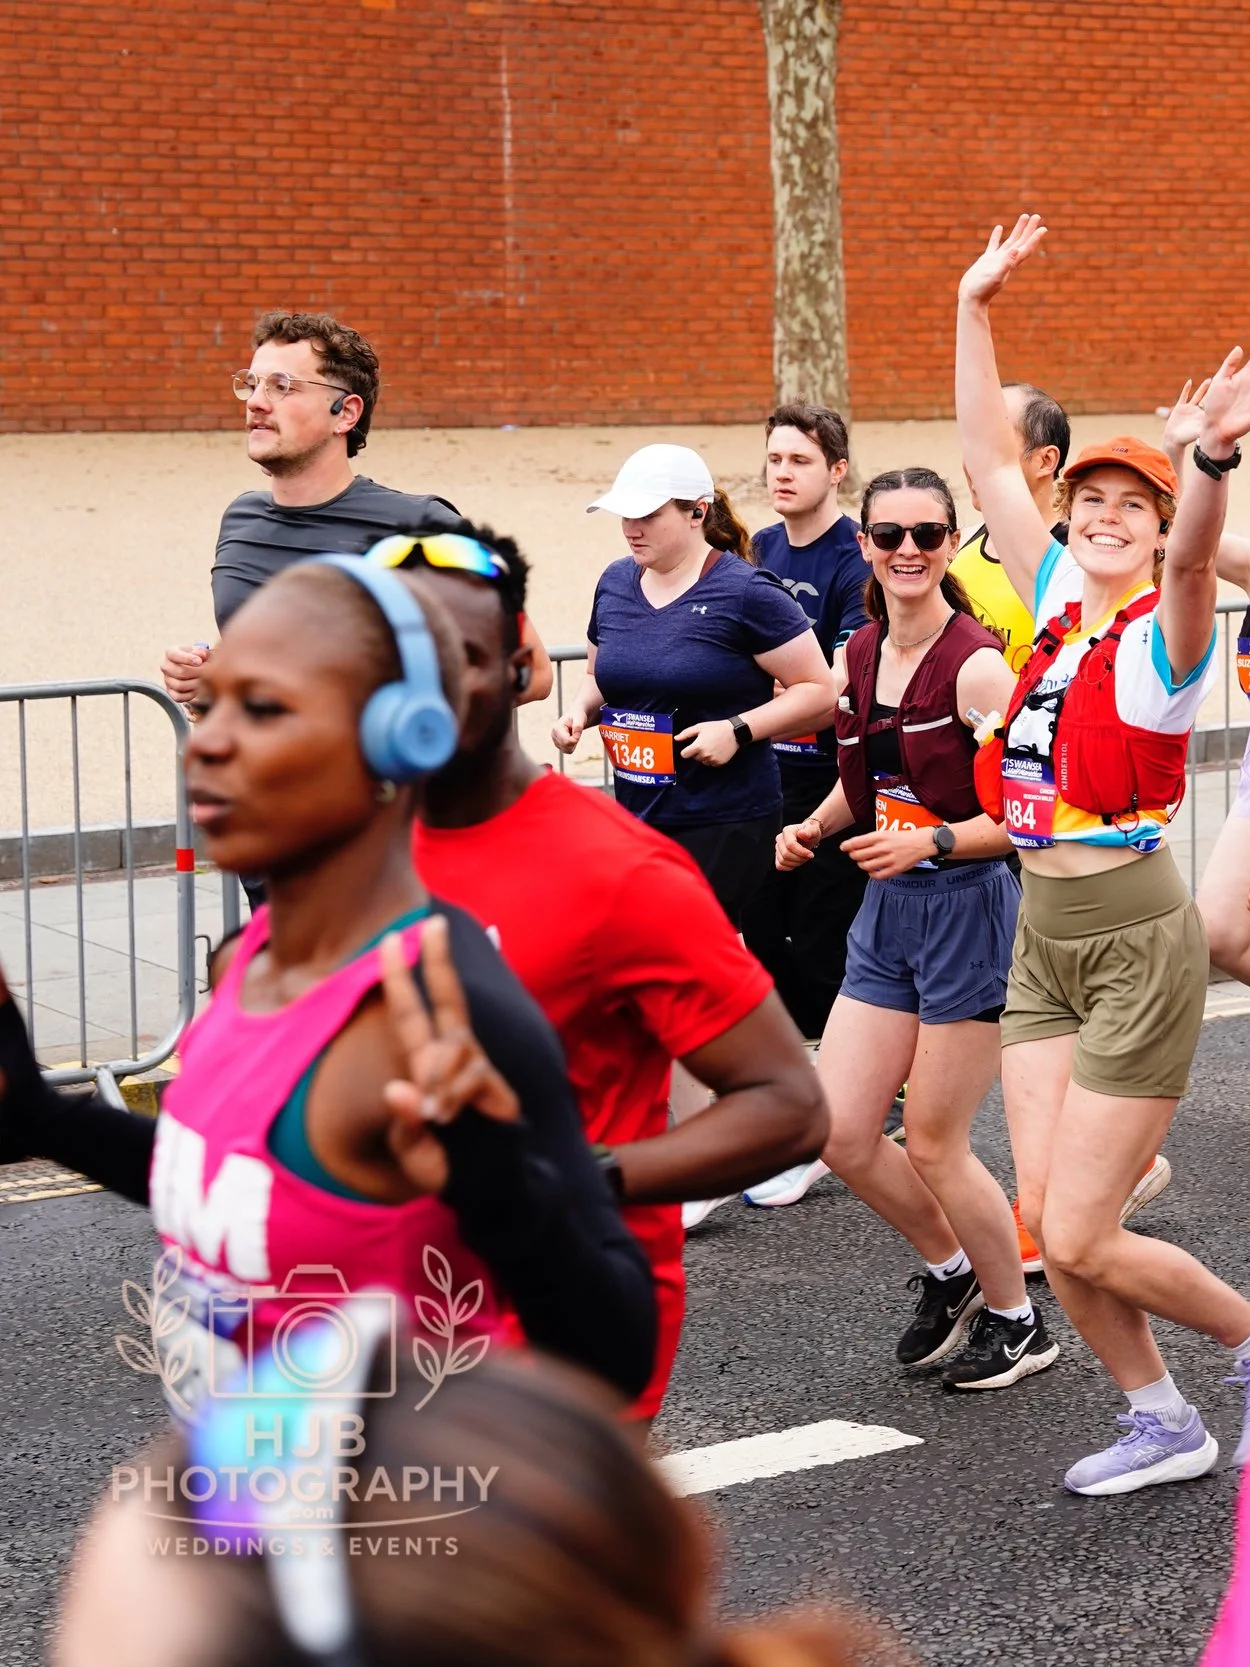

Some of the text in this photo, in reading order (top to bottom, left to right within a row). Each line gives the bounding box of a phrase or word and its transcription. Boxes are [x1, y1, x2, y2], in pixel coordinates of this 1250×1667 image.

[612, 743, 655, 770] 1348
[1008, 758, 1042, 771] SWANSEA
[946, 864, 993, 885] UNDER
